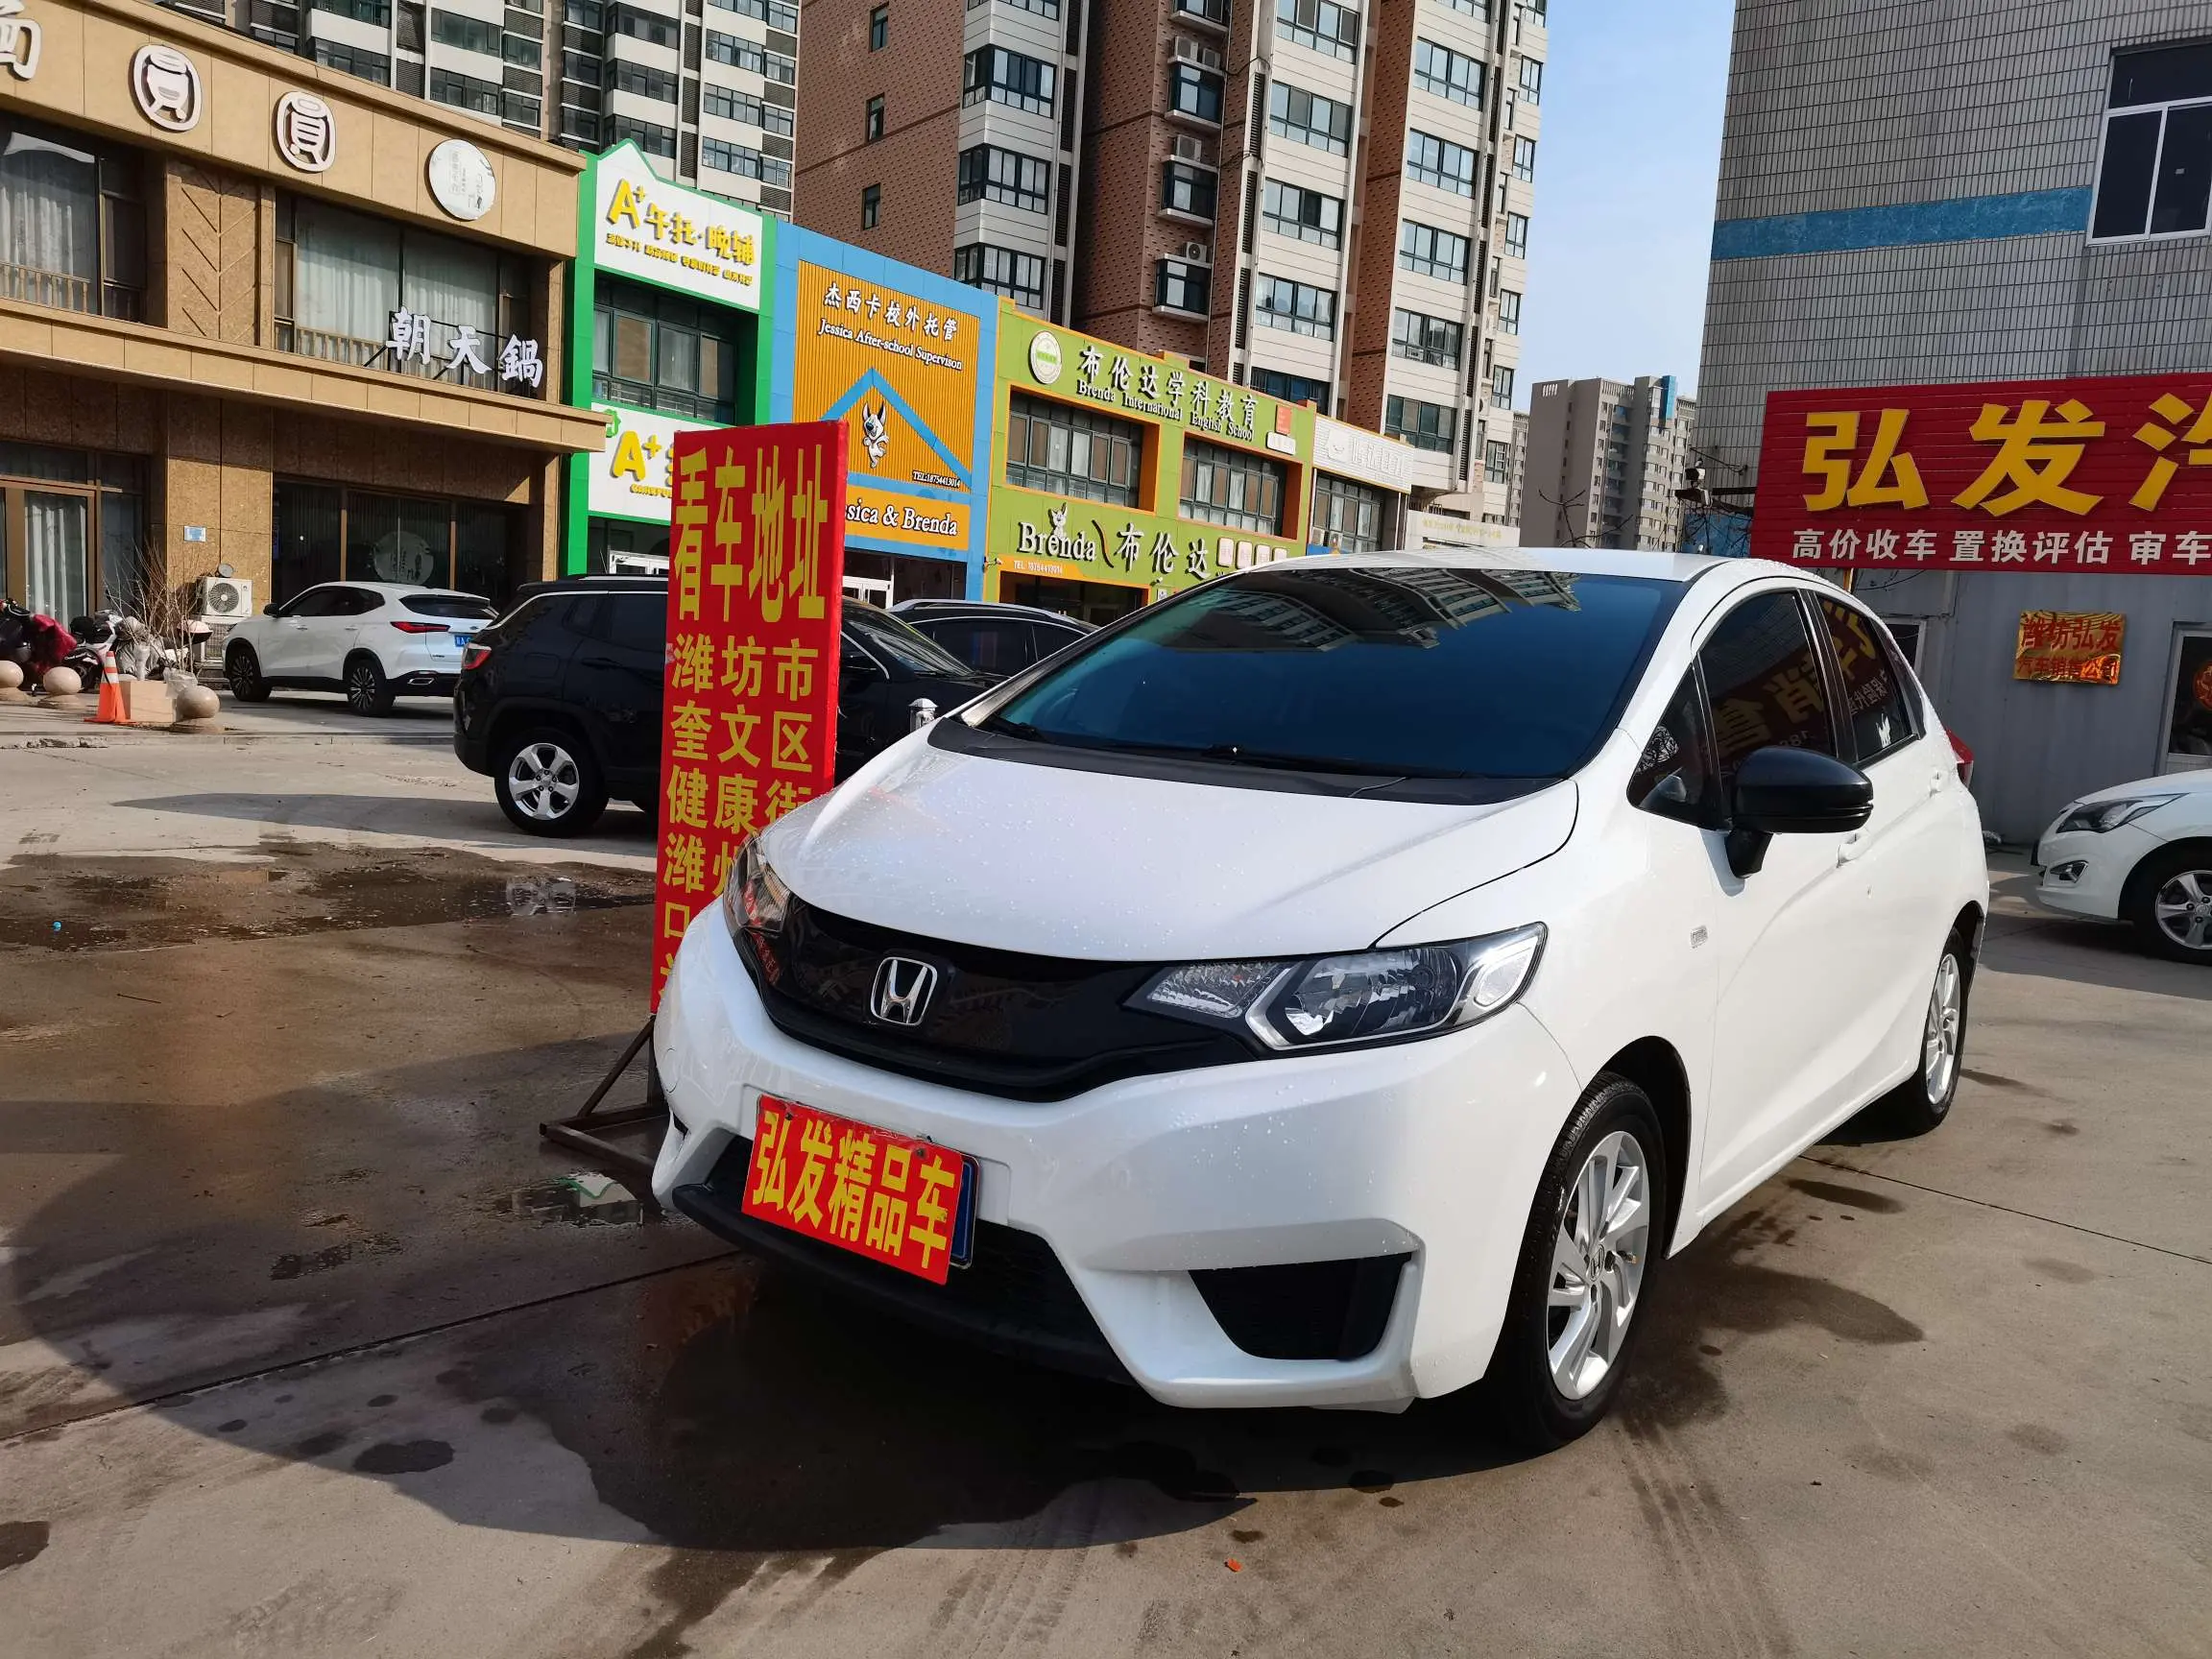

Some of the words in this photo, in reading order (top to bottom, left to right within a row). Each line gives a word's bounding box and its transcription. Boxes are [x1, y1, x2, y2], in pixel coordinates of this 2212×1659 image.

[819, 318, 854, 340] Jessica
[854, 329, 914, 356] After-school
[824, 281, 958, 341] 杰西卡校外托管
[1076, 379, 1116, 403] Brenda
[1122, 392, 1183, 421] International
[1190, 412, 1222, 433] English
[1227, 422, 1255, 442] School
[1077, 345, 1259, 429] 布伦达学科教育
[675, 445, 828, 622] 看车地址
[846, 497, 878, 524] sica
[882, 505, 899, 526] &
[902, 507, 958, 536] Brenda
[1791, 528, 1938, 562] 高价收车
[1949, 530, 2114, 565] 置换评估
[2128, 530, 2212, 565] 审车
[1017, 521, 1097, 562] Brenda
[1114, 522, 1211, 581] 布伦达
[671, 634, 819, 702] 潍坊市
[670, 700, 813, 774] 奎文区
[752, 1110, 956, 1269] 弘发精品车
